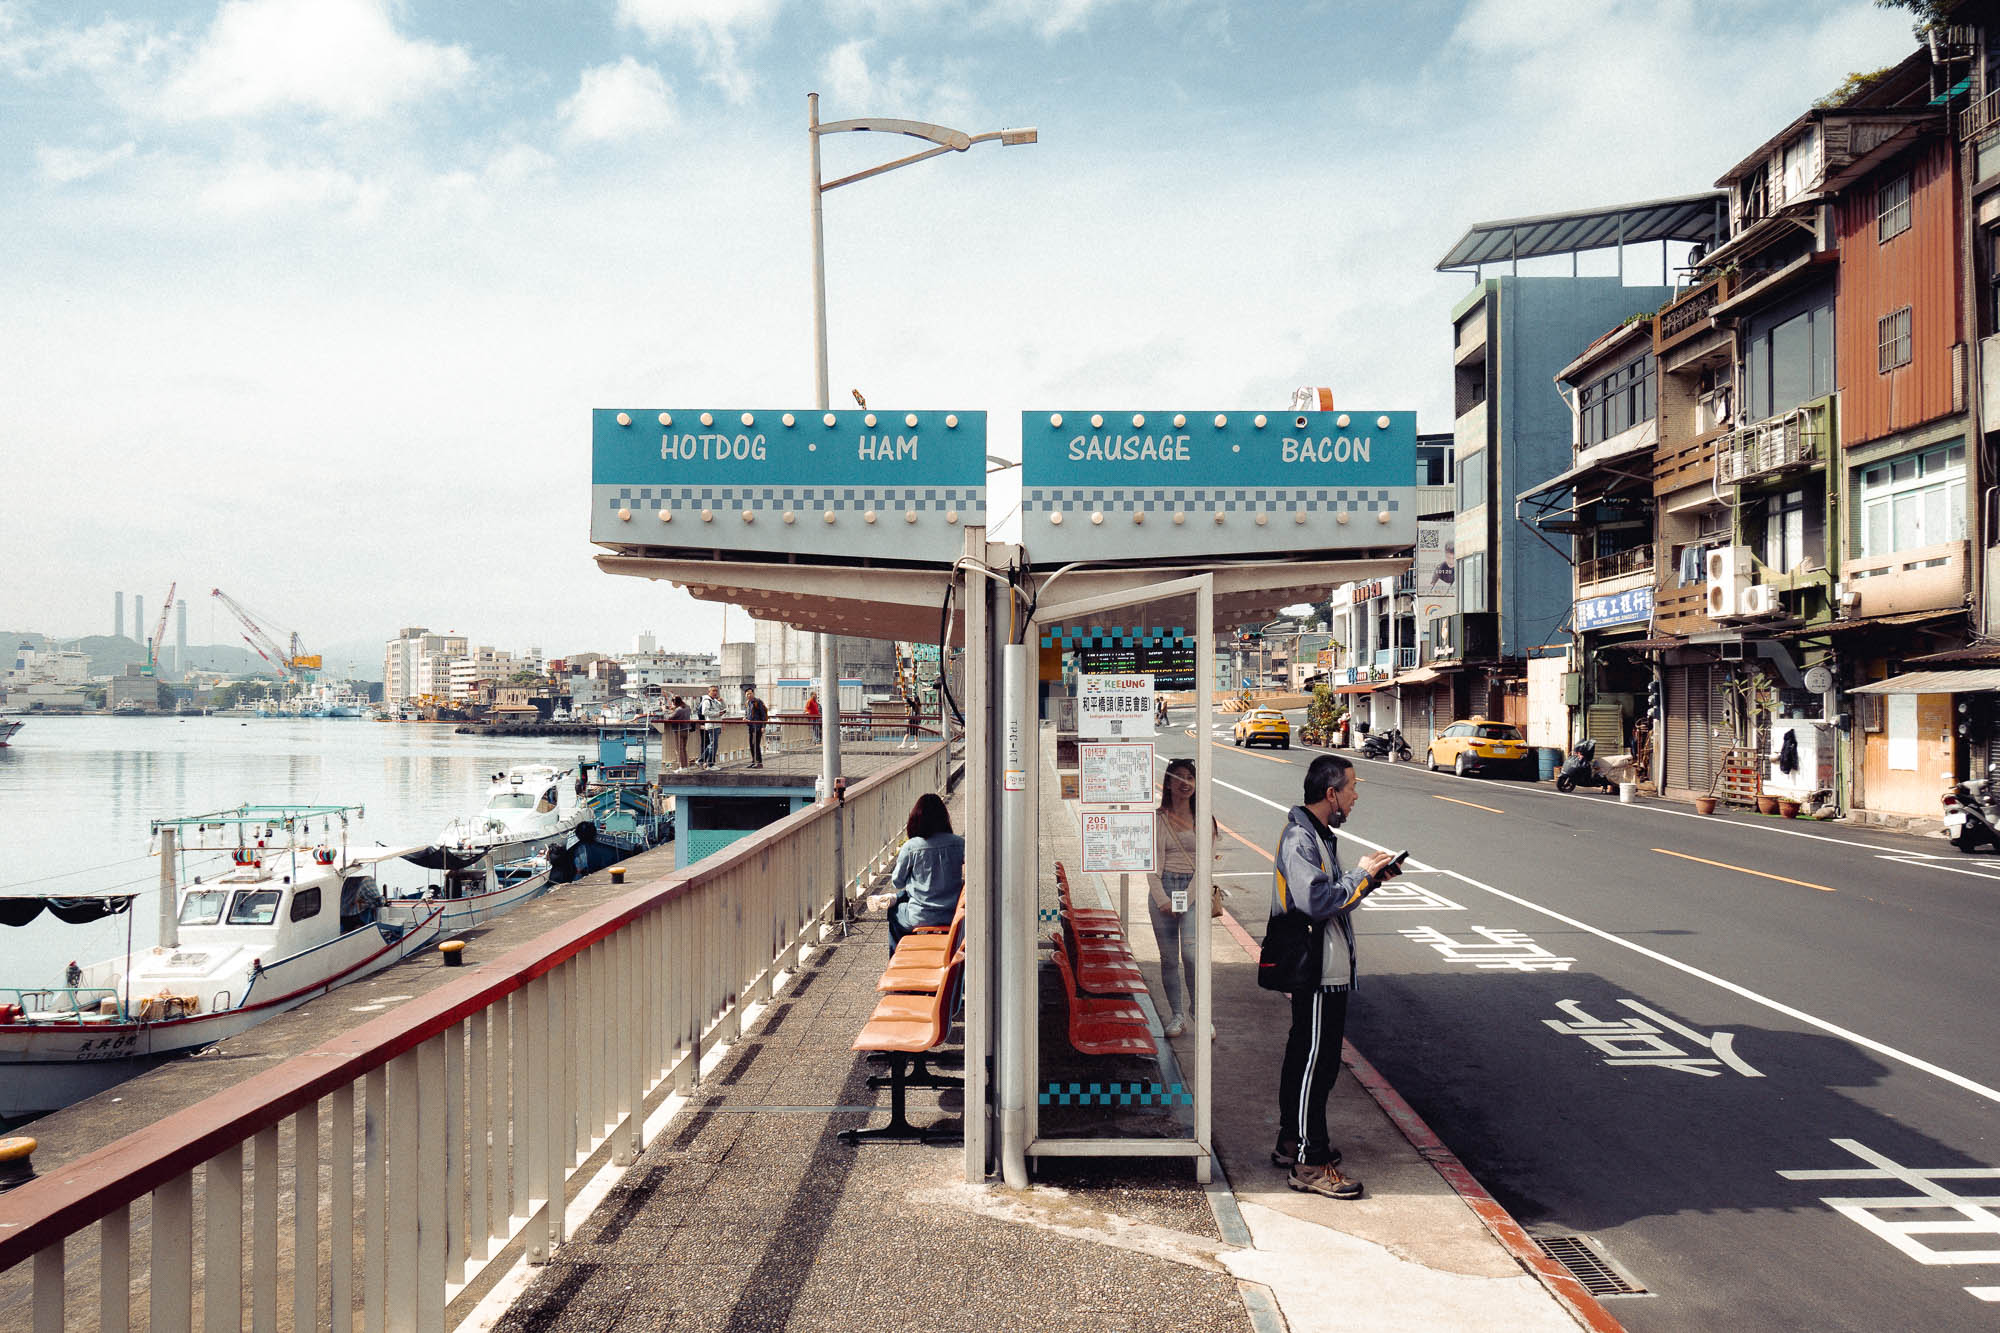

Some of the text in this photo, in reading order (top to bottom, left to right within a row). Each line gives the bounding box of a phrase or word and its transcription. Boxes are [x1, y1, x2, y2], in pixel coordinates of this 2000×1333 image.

[660, 433, 919, 461] HOTDOG HAM
[1068, 434, 1371, 463] SAUSAGE BACON
[1104, 679, 1145, 689] KEELUNG
[1083, 696, 1151, 713] 和平橋頭(原民會館)
[1088, 816, 1106, 824] 205
